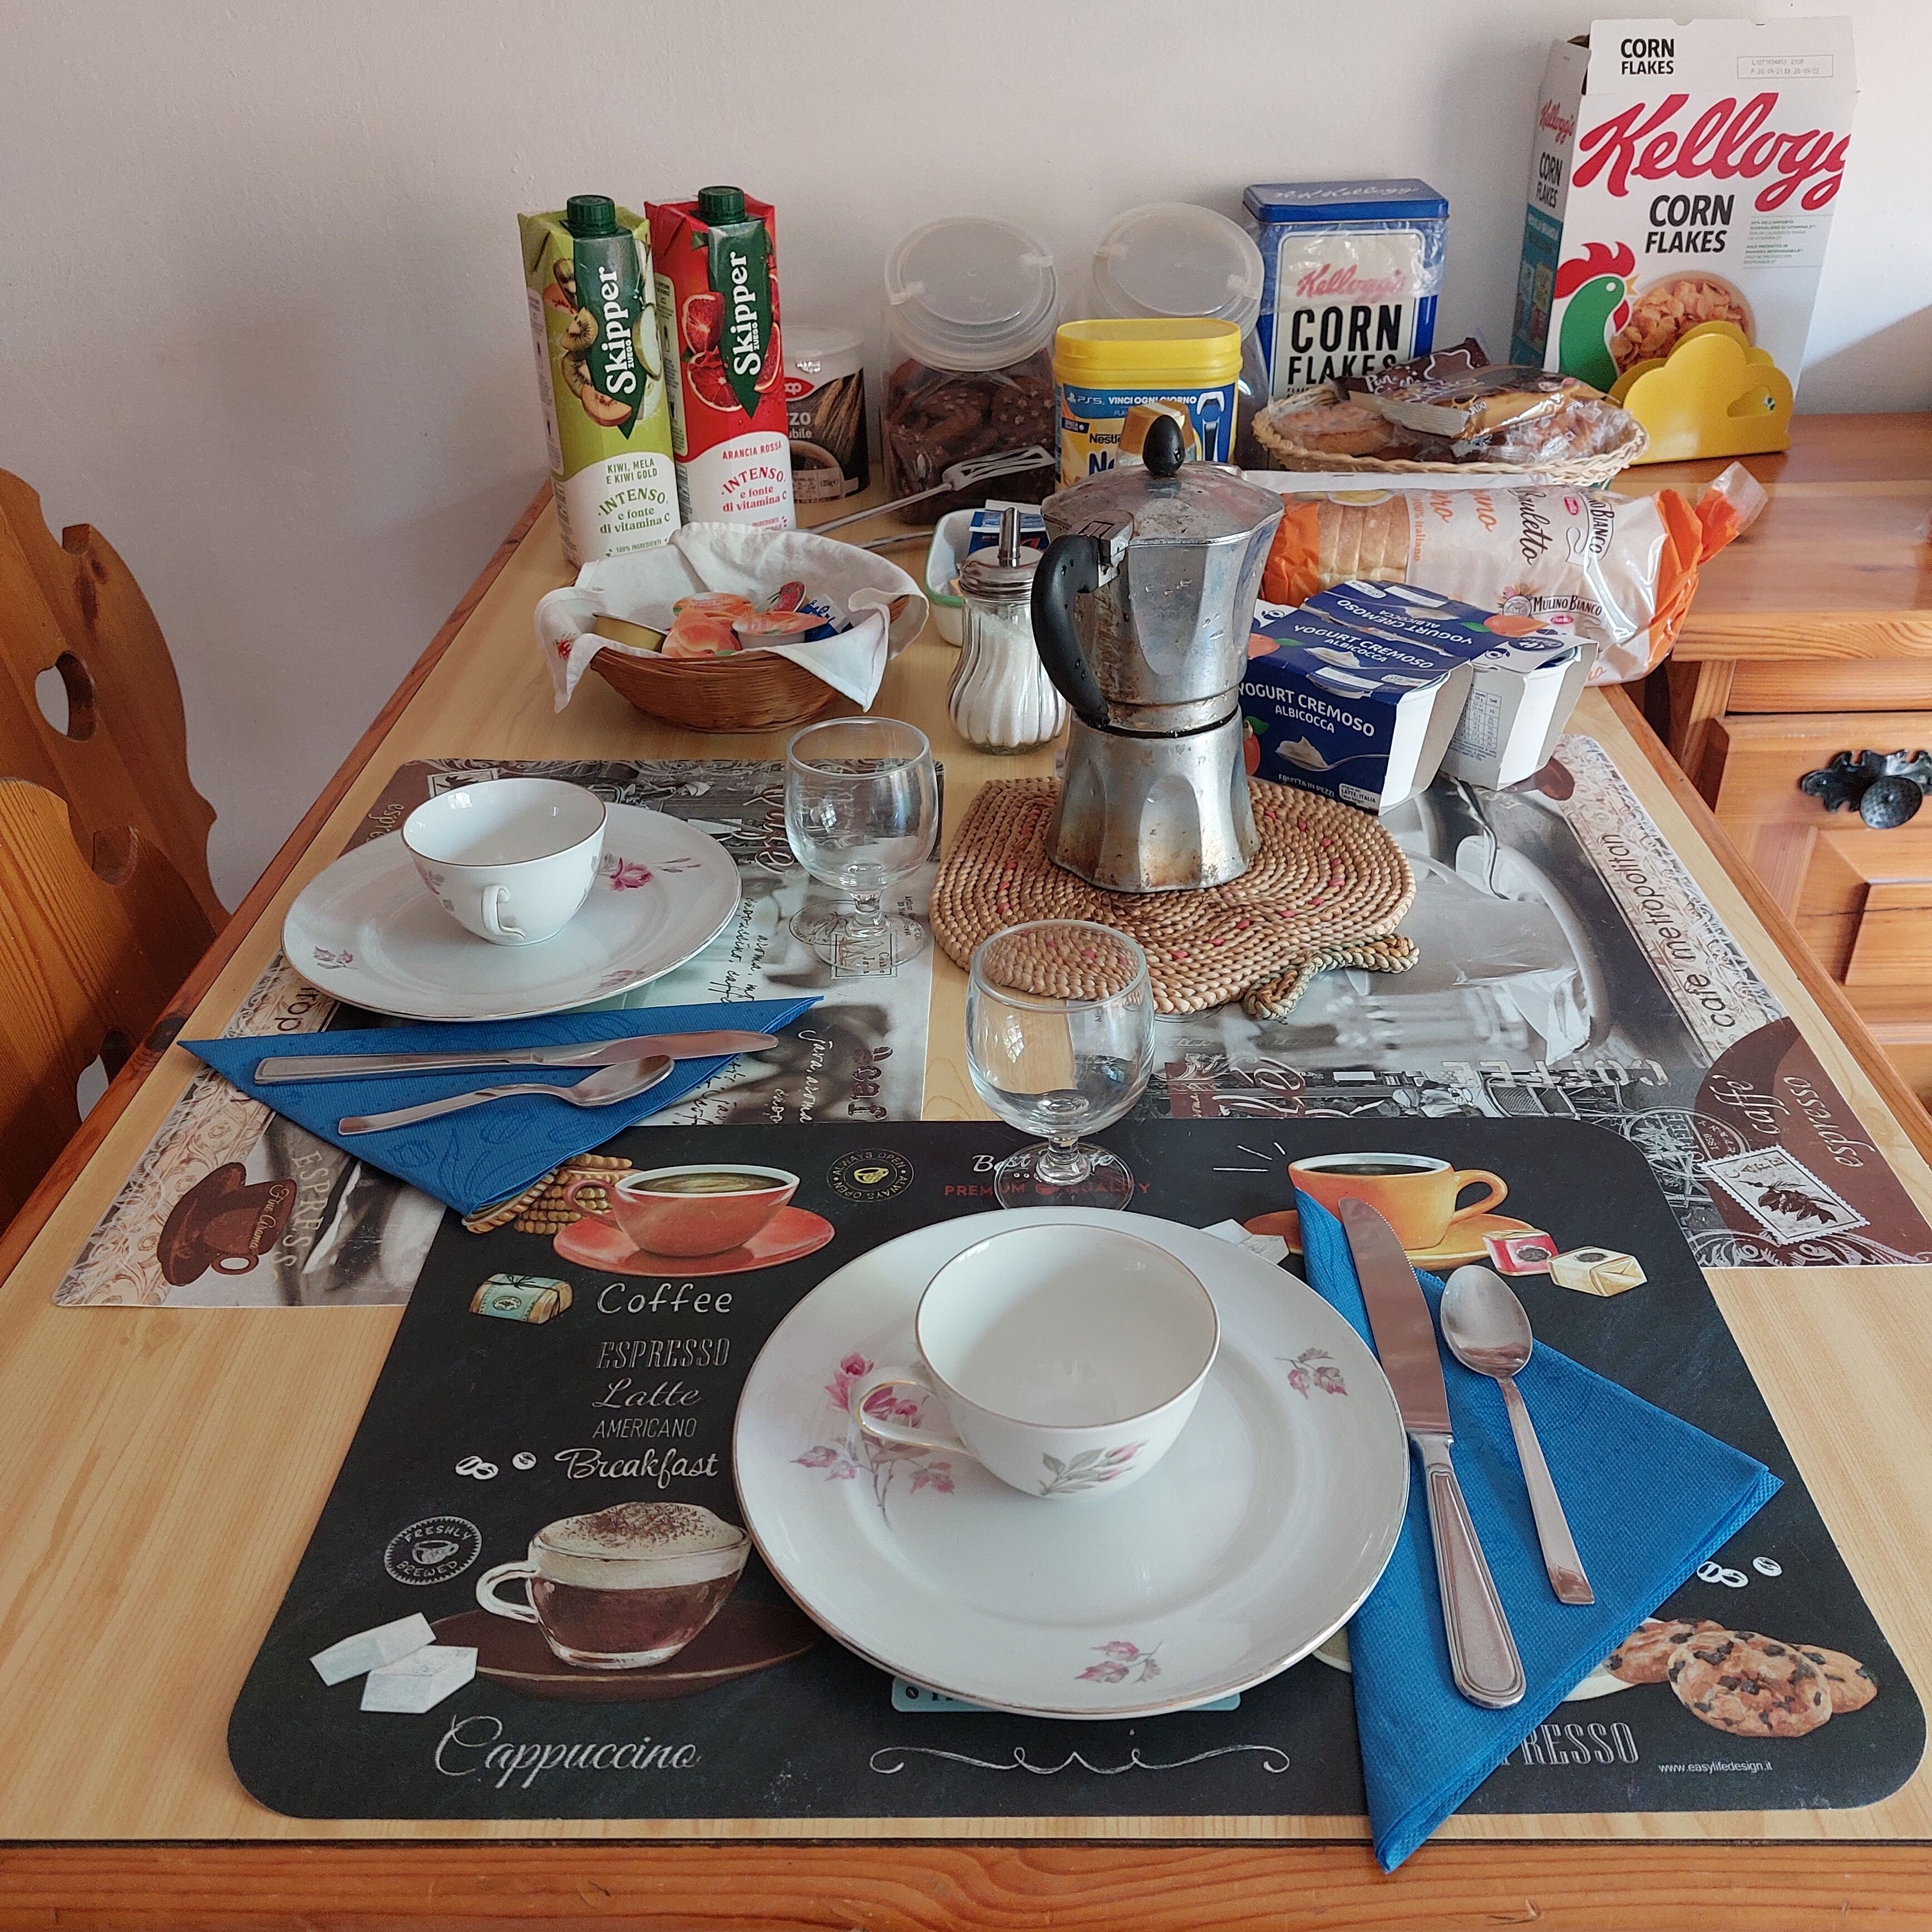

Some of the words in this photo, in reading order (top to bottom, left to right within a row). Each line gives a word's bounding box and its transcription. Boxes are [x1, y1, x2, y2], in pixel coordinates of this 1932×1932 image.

[1620, 38, 1675, 58] CORN
[1621, 60, 1674, 75] FLAKES
[1539, 151, 1563, 186] CORN
[1536, 181, 1558, 208] FLAKES
[1649, 195, 1734, 226] CORN
[1645, 230, 1727, 253] FLAKES
[730, 251, 762, 376] Skipper
[598, 266, 637, 395] Skipper
[1291, 304, 1402, 354] CORN
[1108, 396, 1134, 405] VINCI
[722, 447, 758, 460] ARANCIA
[760, 440, 782, 454] ROSSA
[606, 476, 612, 485] E
[614, 472, 634, 484] KIWI
[637, 468, 658, 480] GOLD
[607, 461, 630, 474] KIWI,
[633, 457, 655, 470] MELA
[722, 466, 784, 495] INTENSO
[749, 486, 774, 497] fonte
[599, 487, 666, 515] INTENSO
[627, 507, 655, 519] fonte
[723, 502, 734, 512] di
[736, 496, 780, 511] vitamina
[782, 490, 787, 500] C
[600, 524, 612, 534] di
[614, 517, 662, 533] vitamina
[664, 512, 671, 523] C
[1507, 489, 1554, 565] Bauletto
[1588, 508, 1615, 554] BIANCO
[1414, 520, 1427, 562] italiano
[1337, 599, 1406, 628] CREMOSO
[1379, 609, 1441, 628] ALBICOCCA
[1294, 625, 1358, 644] YOGURT
[1359, 640, 1435, 669] CREMOSO
[1404, 624, 1472, 645] YOGURT
[1324, 638, 1388, 663] ALBICOCCA
[1238, 682, 1295, 704] YOGURT
[1298, 694, 1375, 737] CREMOSO
[1275, 704, 1335, 734] ALBICOCCA
[1278, 773, 1307, 788] FRUTTA
[1307, 781, 1315, 789] IN
[1316, 783, 1335, 799] PEZZI
[1359, 793, 1376, 804] ITALIA
[1601, 834, 1696, 962] metropolitan
[1441, 1058, 1670, 1089] COFFEE
[1783, 1075, 1876, 1168] espresso
[832, 1151, 873, 1176] ALWAYS
[878, 1152, 906, 1169] OPEN
[269, 1184, 290, 1213] Fine
[833, 1181, 862, 1199] OPEN
[866, 1175, 909, 1200] ALWAYS
[597, 1282, 734, 1314] Coffee
[595, 1338, 730, 1369] ESPRESSO
[592, 1377, 702, 1409] Latte
[592, 1417, 697, 1439] AMERICANO
[553, 1447, 719, 1489] Breakfast
[403, 1525, 474, 1543] FRESHLY
[433, 1713, 703, 1790] Cappuccino
[1502, 1722, 1640, 1766] RESSO
[1658, 1759, 1773, 1776] www.easylifedesign.it
